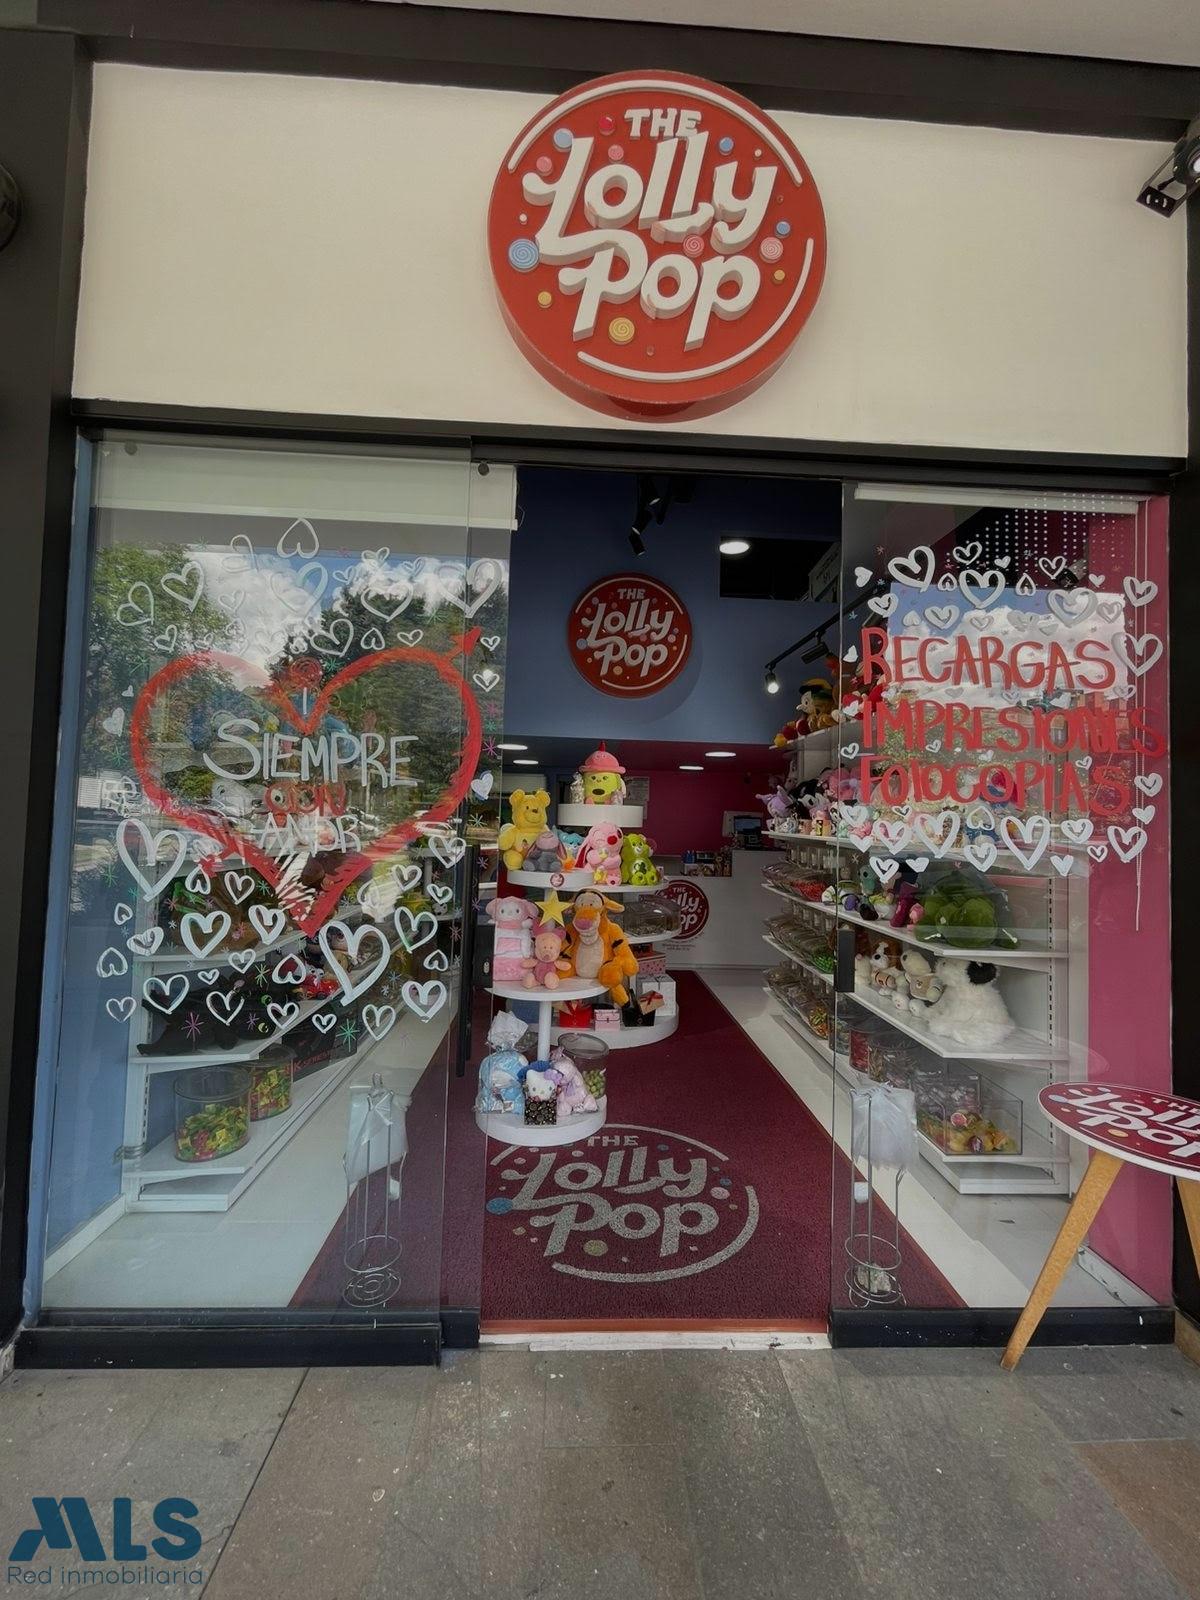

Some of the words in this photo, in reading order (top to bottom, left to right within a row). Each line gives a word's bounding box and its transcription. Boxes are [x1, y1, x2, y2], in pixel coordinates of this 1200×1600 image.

[624, 107, 702, 139] THE
[522, 131, 778, 265] Lolly
[558, 229, 761, 352] Pop
[581, 599, 674, 648] Lolly
[617, 588, 646, 600] THE
[594, 636, 668, 678] Pop
[860, 627, 1117, 692] RECARGAS
[203, 718, 419, 789] SIEMPRE
[860, 699, 1168, 759] IMPRESIONES
[587, 1135, 640, 1147] THE
[501, 1147, 707, 1210] Lolly
[530, 1192, 719, 1257] Pop
